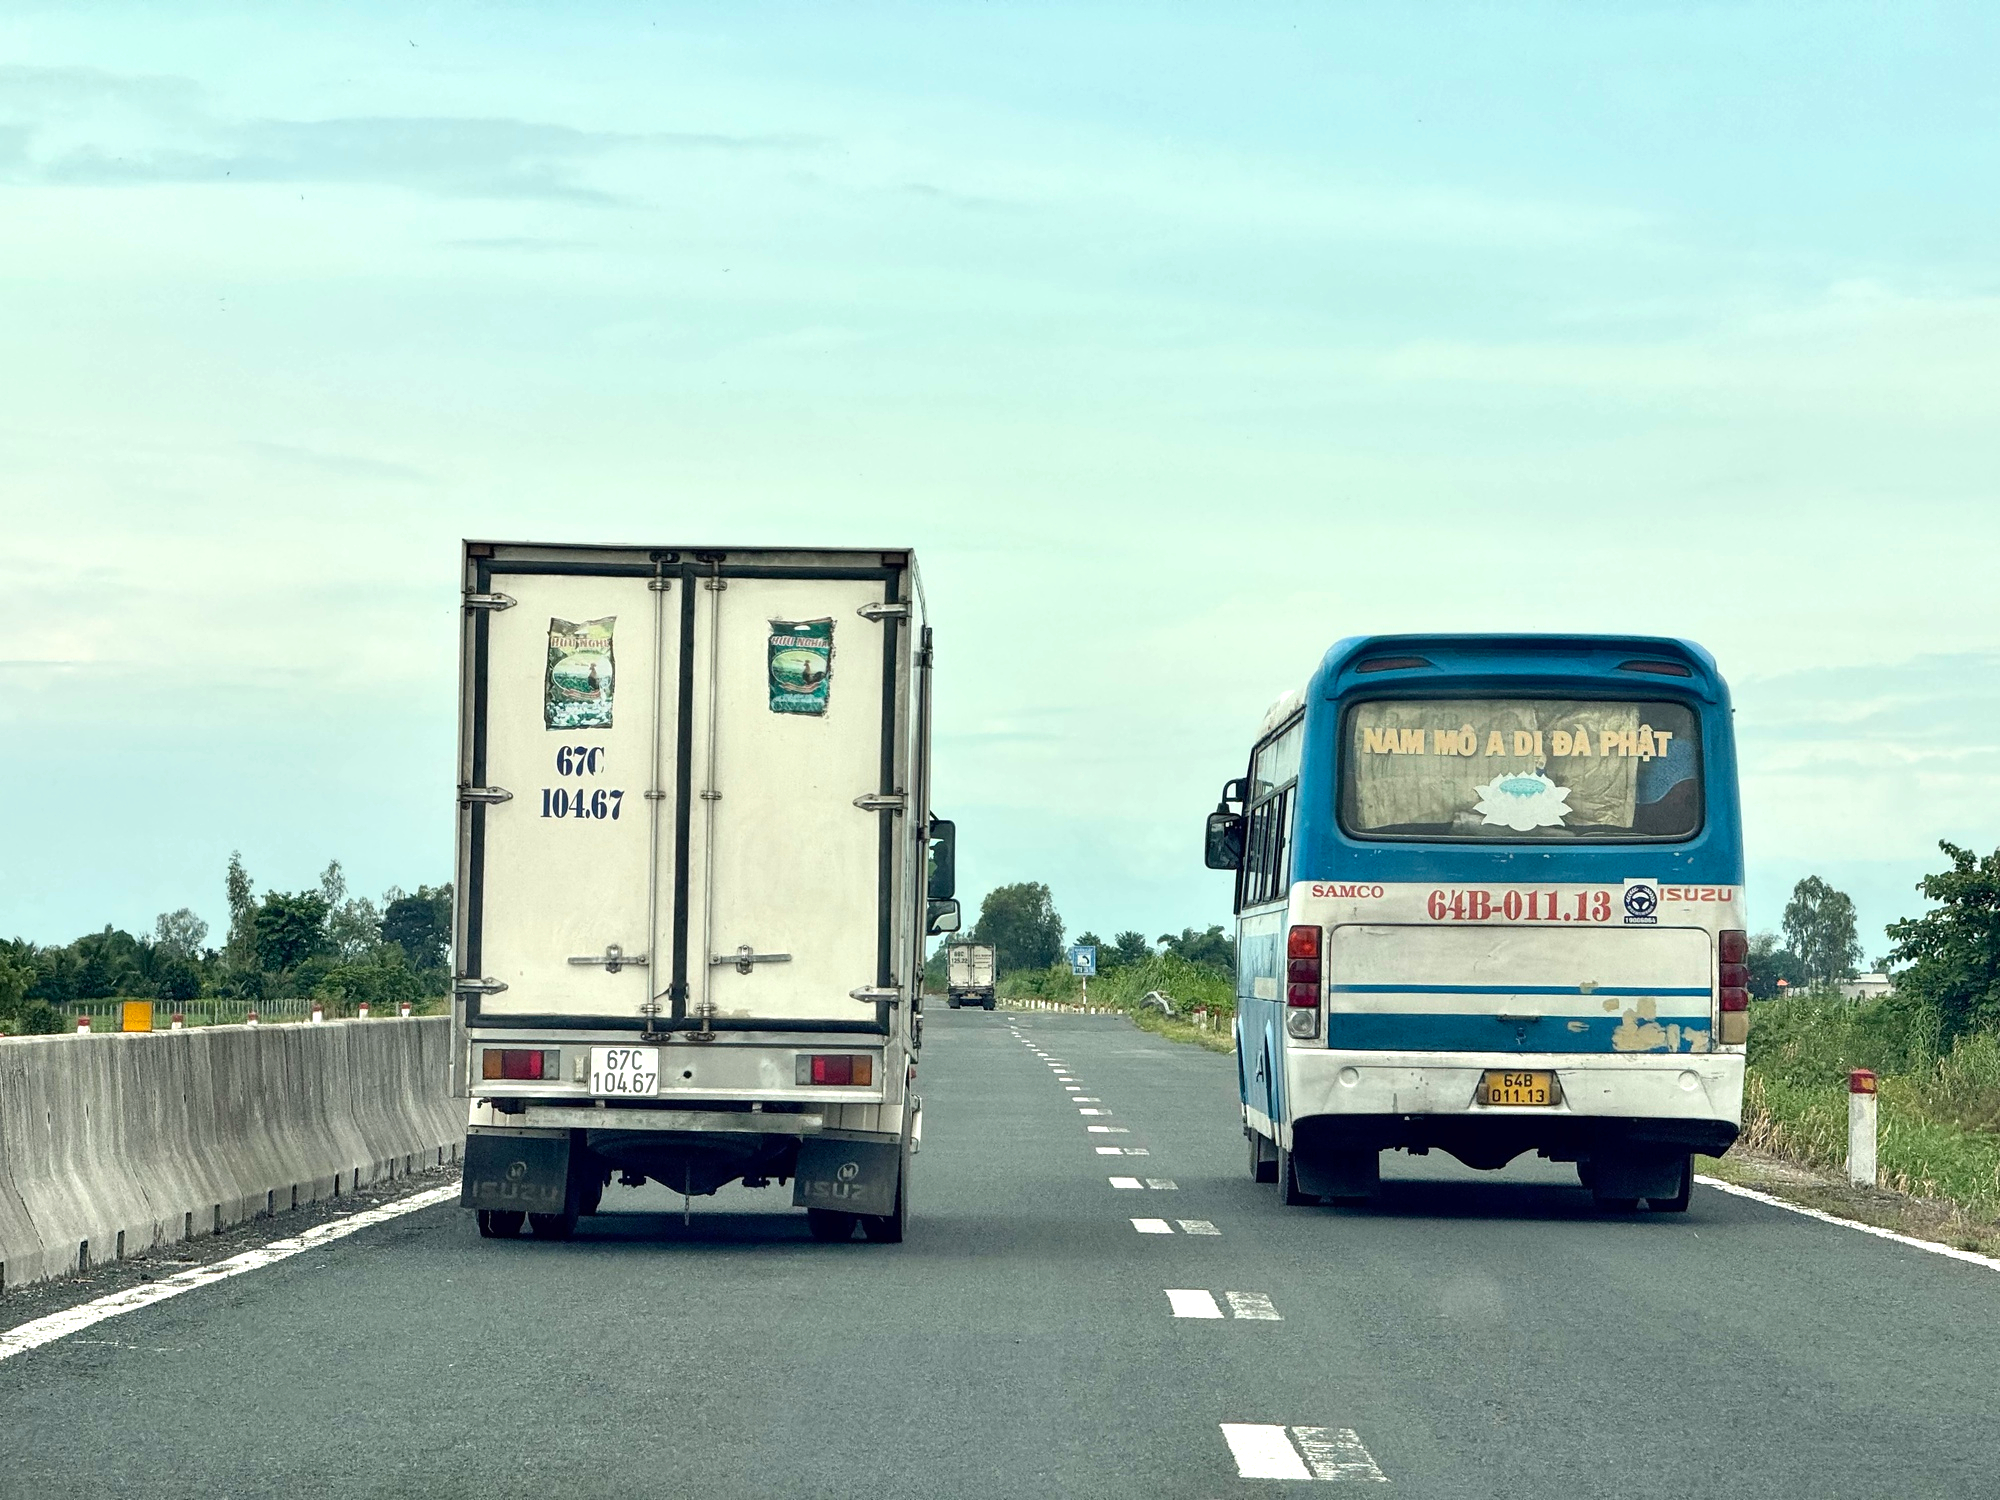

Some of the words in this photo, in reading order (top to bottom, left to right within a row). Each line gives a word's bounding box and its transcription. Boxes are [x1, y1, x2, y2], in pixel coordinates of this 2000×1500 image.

[1363, 728, 1424, 754] NAM
[1434, 724, 1477, 756] MÔ
[1485, 731, 1506, 756] A
[1552, 724, 1592, 756] ĐÀ
[1600, 724, 1672, 761] PHẬT
[556, 745, 605, 776] 67C
[540, 788, 625, 820] 104.67
[1312, 884, 1384, 898] SAMCO
[1660, 888, 1732, 902] ISUZU
[1427, 889, 1611, 921] 64B-011.13
[607, 1049, 643, 1070] 67C
[593, 1071, 657, 1094] 104.67
[1504, 1073, 1533, 1087] 64B
[1492, 1088, 1545, 1103] 011.13
